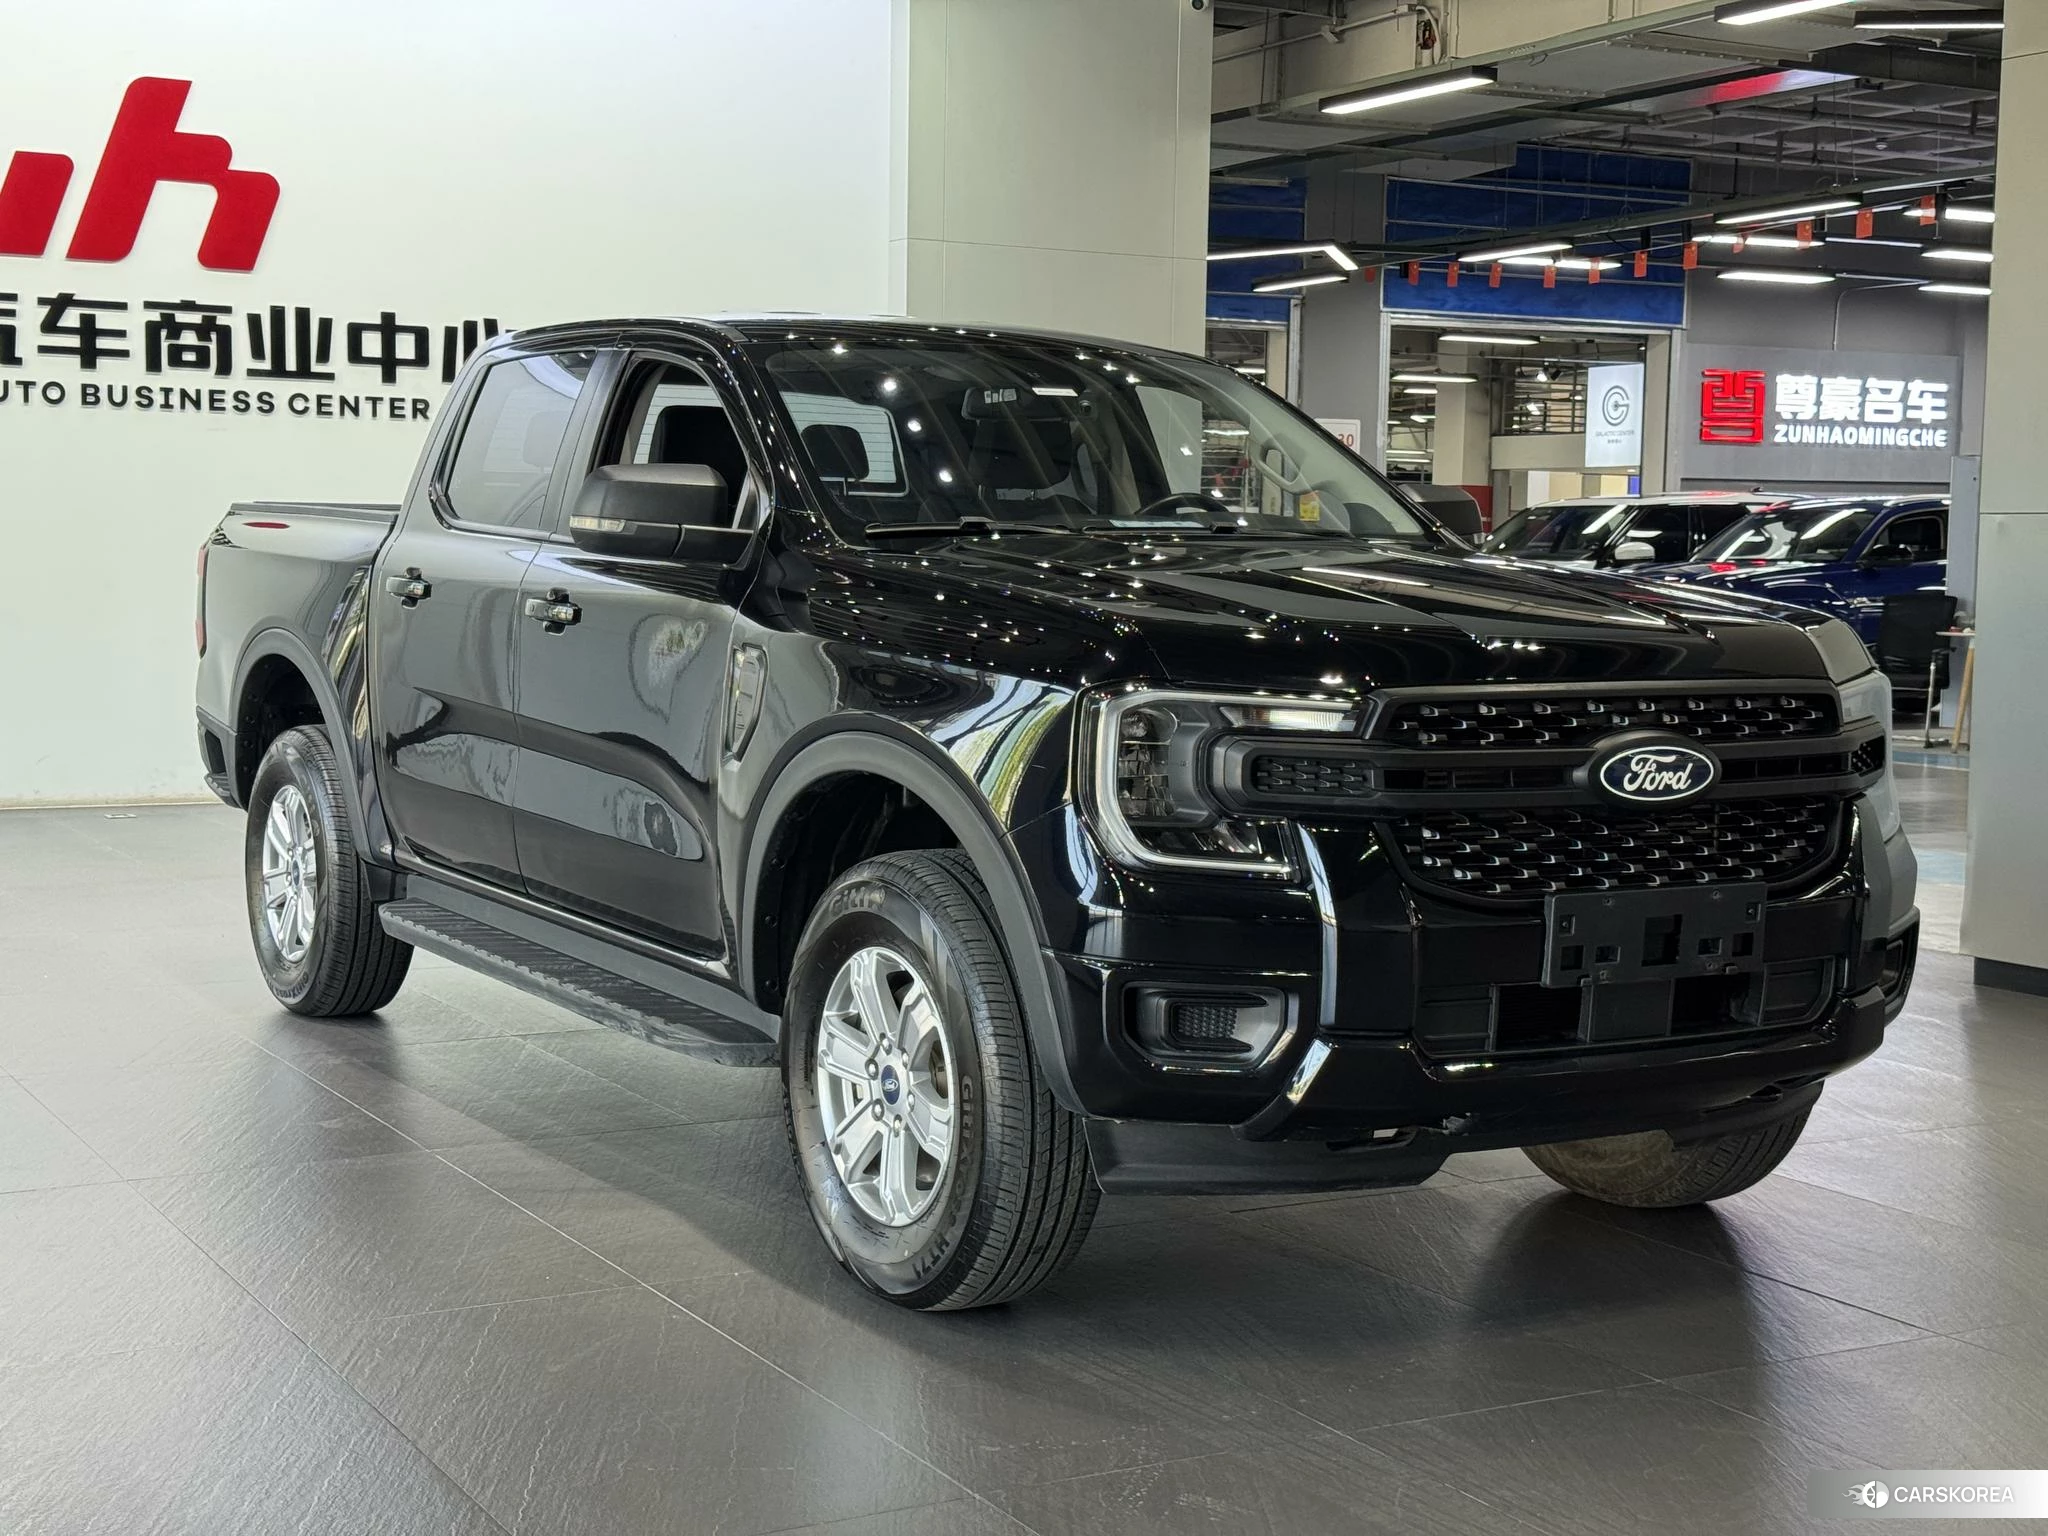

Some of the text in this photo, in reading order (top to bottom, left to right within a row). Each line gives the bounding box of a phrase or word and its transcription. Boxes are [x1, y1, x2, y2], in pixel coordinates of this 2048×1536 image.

[0, 292, 518, 384] 车商业中
[81, 383, 275, 414] BUSINESS
[288, 392, 430, 419] CENTER
[1775, 374, 1949, 424] 尊豪名车
[1773, 424, 1949, 448] ZUNHAOMINGCHE
[1623, 753, 1694, 792] Ford
